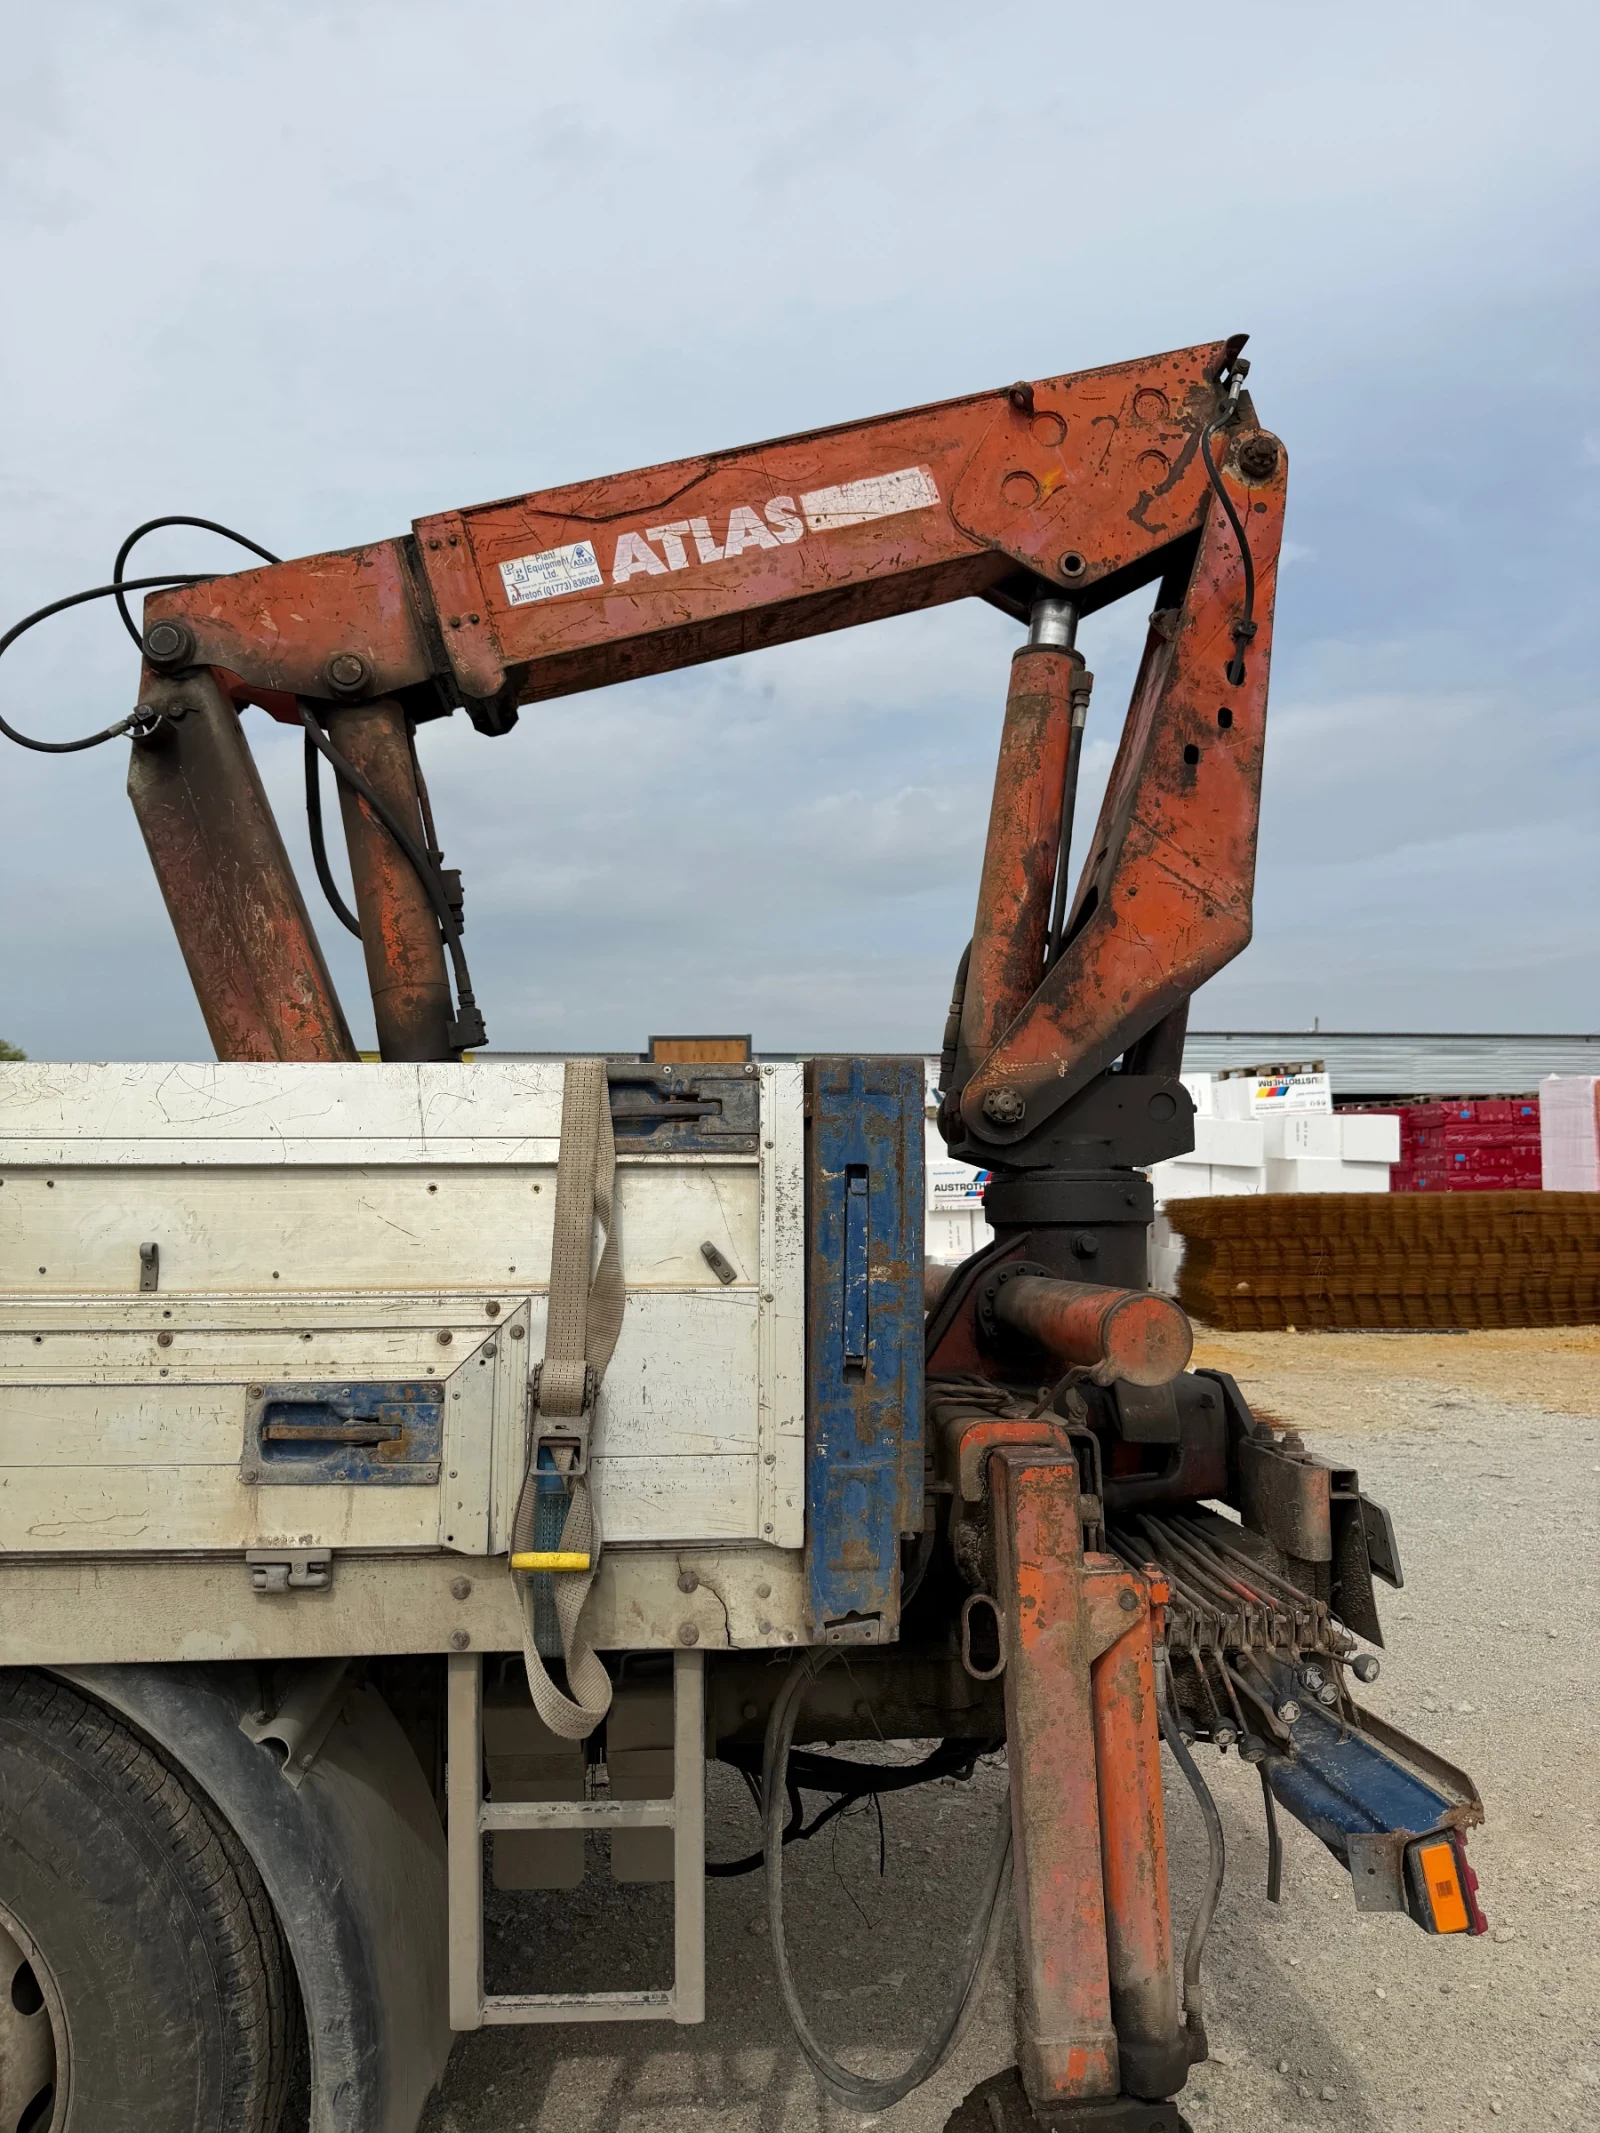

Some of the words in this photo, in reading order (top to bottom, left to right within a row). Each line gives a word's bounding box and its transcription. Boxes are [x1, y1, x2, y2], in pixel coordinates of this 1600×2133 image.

[612, 496, 804, 585] ATLAS
[535, 551, 557, 562] Plant
[573, 557, 593, 567] ATLAS
[526, 556, 570, 574] Equipment
[543, 570, 560, 580] Ltd.
[543, 582, 572, 596] (01773)
[573, 574, 600, 588] 836060
